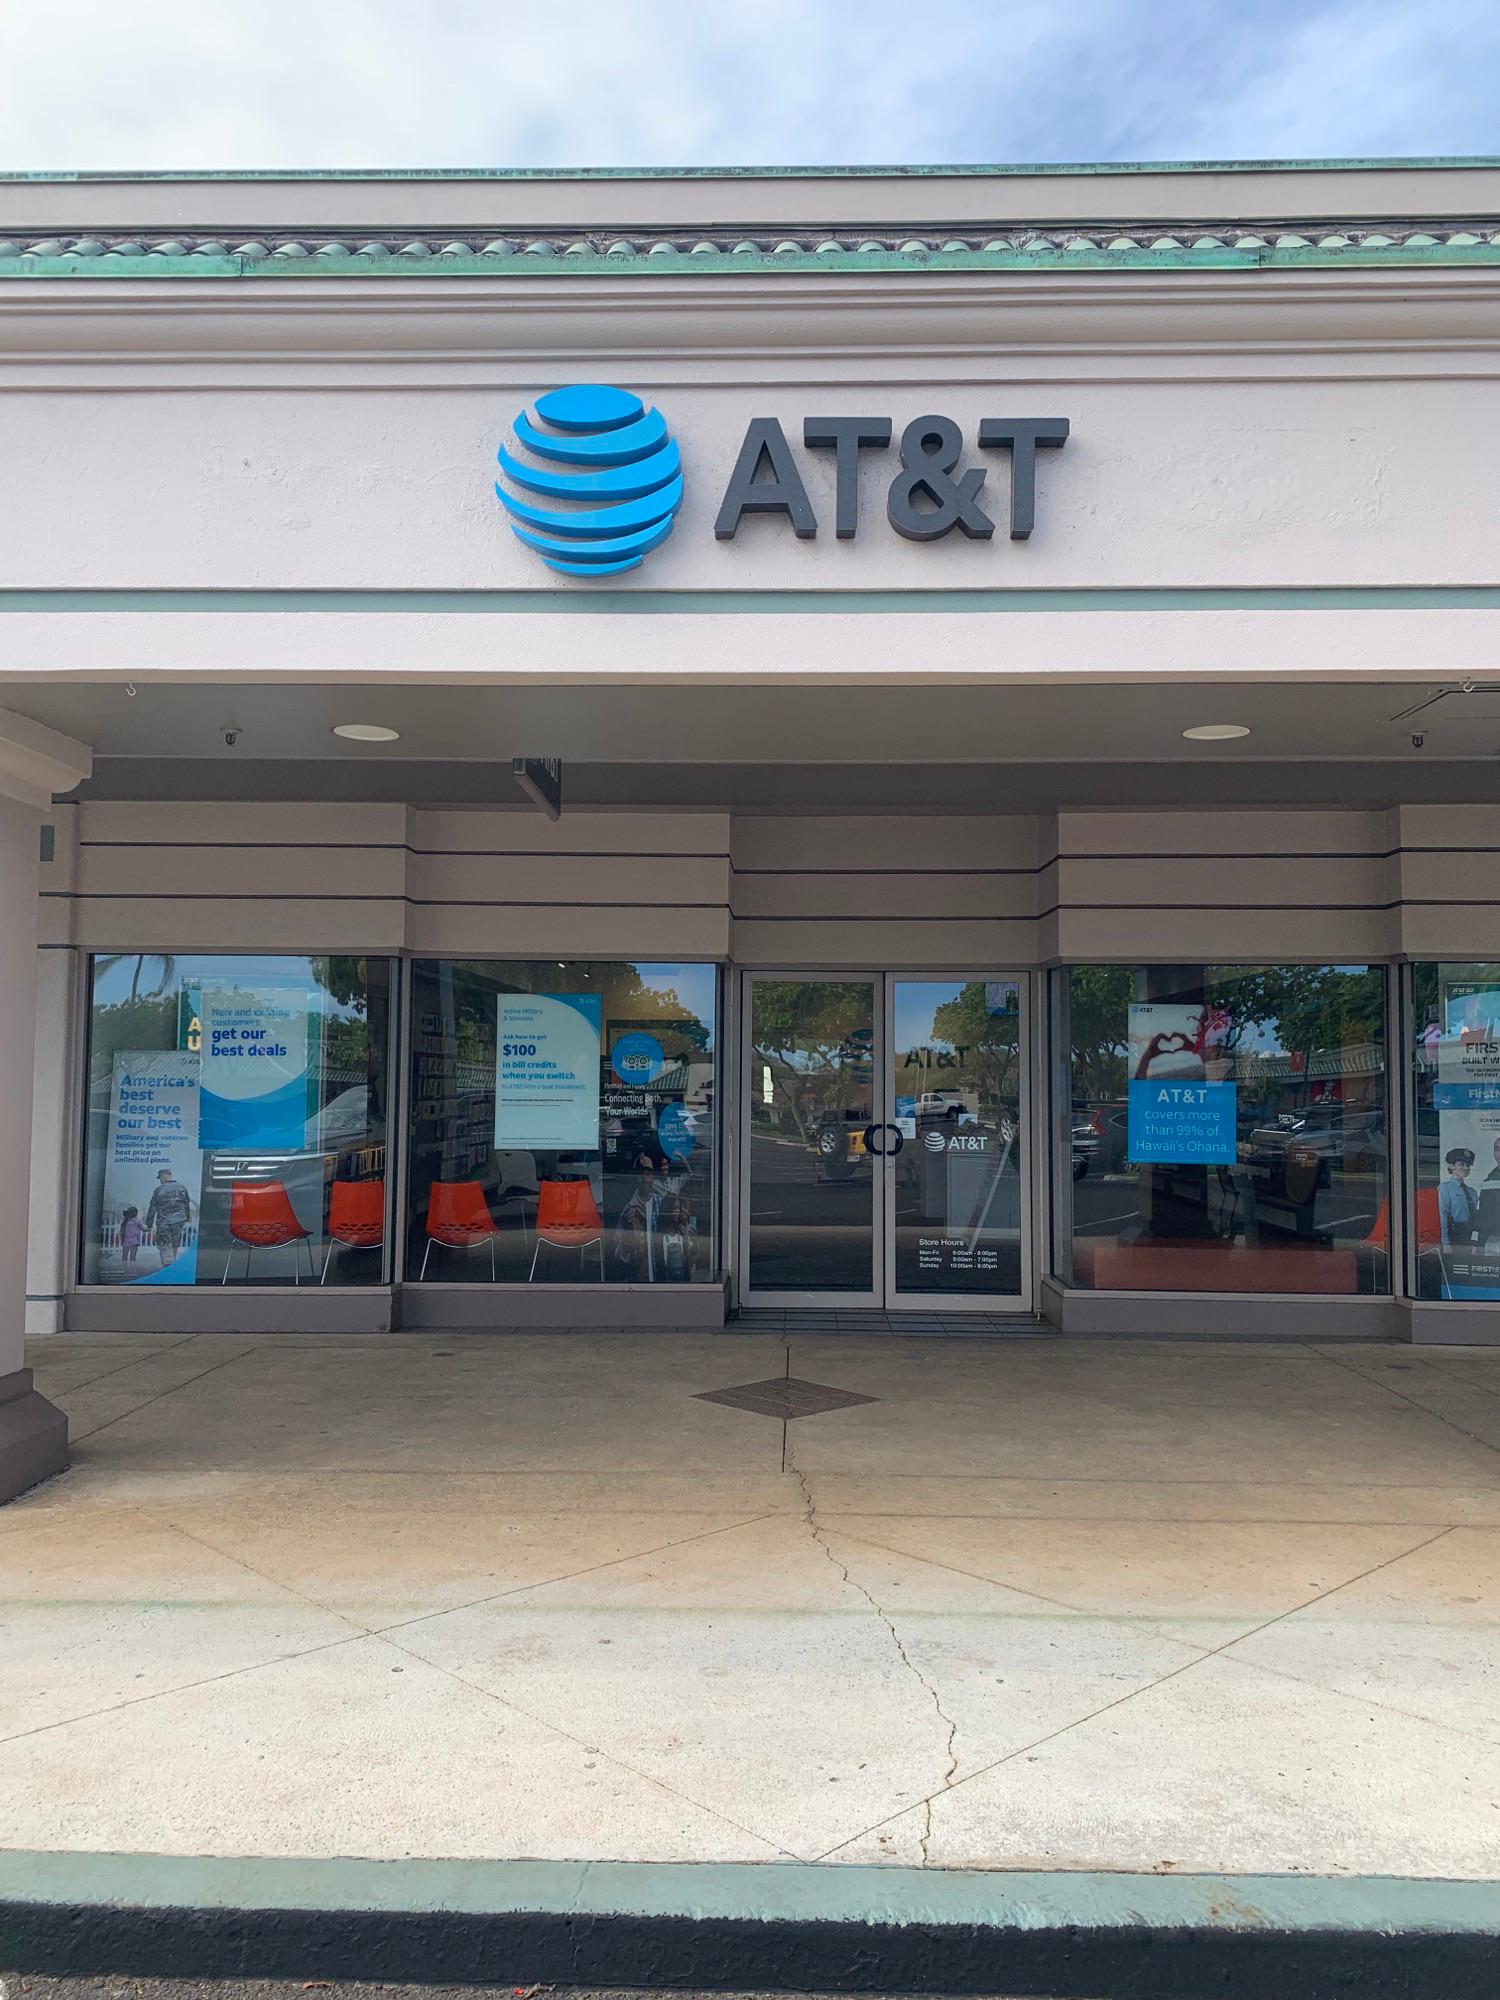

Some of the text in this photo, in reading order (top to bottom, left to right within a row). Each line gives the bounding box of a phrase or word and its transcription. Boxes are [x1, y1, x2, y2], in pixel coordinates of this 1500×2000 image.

[713, 414, 1070, 541] AT&T
[211, 1008, 232, 1017] New
[234, 1008, 251, 1017] and
[212, 1028, 266, 1043] get our
[211, 1044, 287, 1057] best deals
[502, 1043, 537, 1057] $100
[1465, 1042, 1500, 1054] FIRS
[904, 1046, 970, 1068] AT&T
[121, 1074, 195, 1088] America's
[547, 1072, 576, 1080] switch
[120, 1087, 154, 1101] best
[604, 1093, 661, 1104] Connecting Both
[1157, 1089, 1208, 1103] AT&T
[119, 1102, 181, 1115] deserve
[606, 1106, 649, 1116] Your Worlds
[117, 1116, 182, 1129] our best
[1144, 1111, 1221, 1121] covers more
[1145, 1124, 1220, 1137] than 99% of
[116, 1134, 144, 1142] Military
[948, 1136, 988, 1150] AT&T
[133, 1149, 150, 1157] price
[1136, 1140, 1230, 1153] Hawaii's Ohana.
[115, 1156, 149, 1164] unlimited
